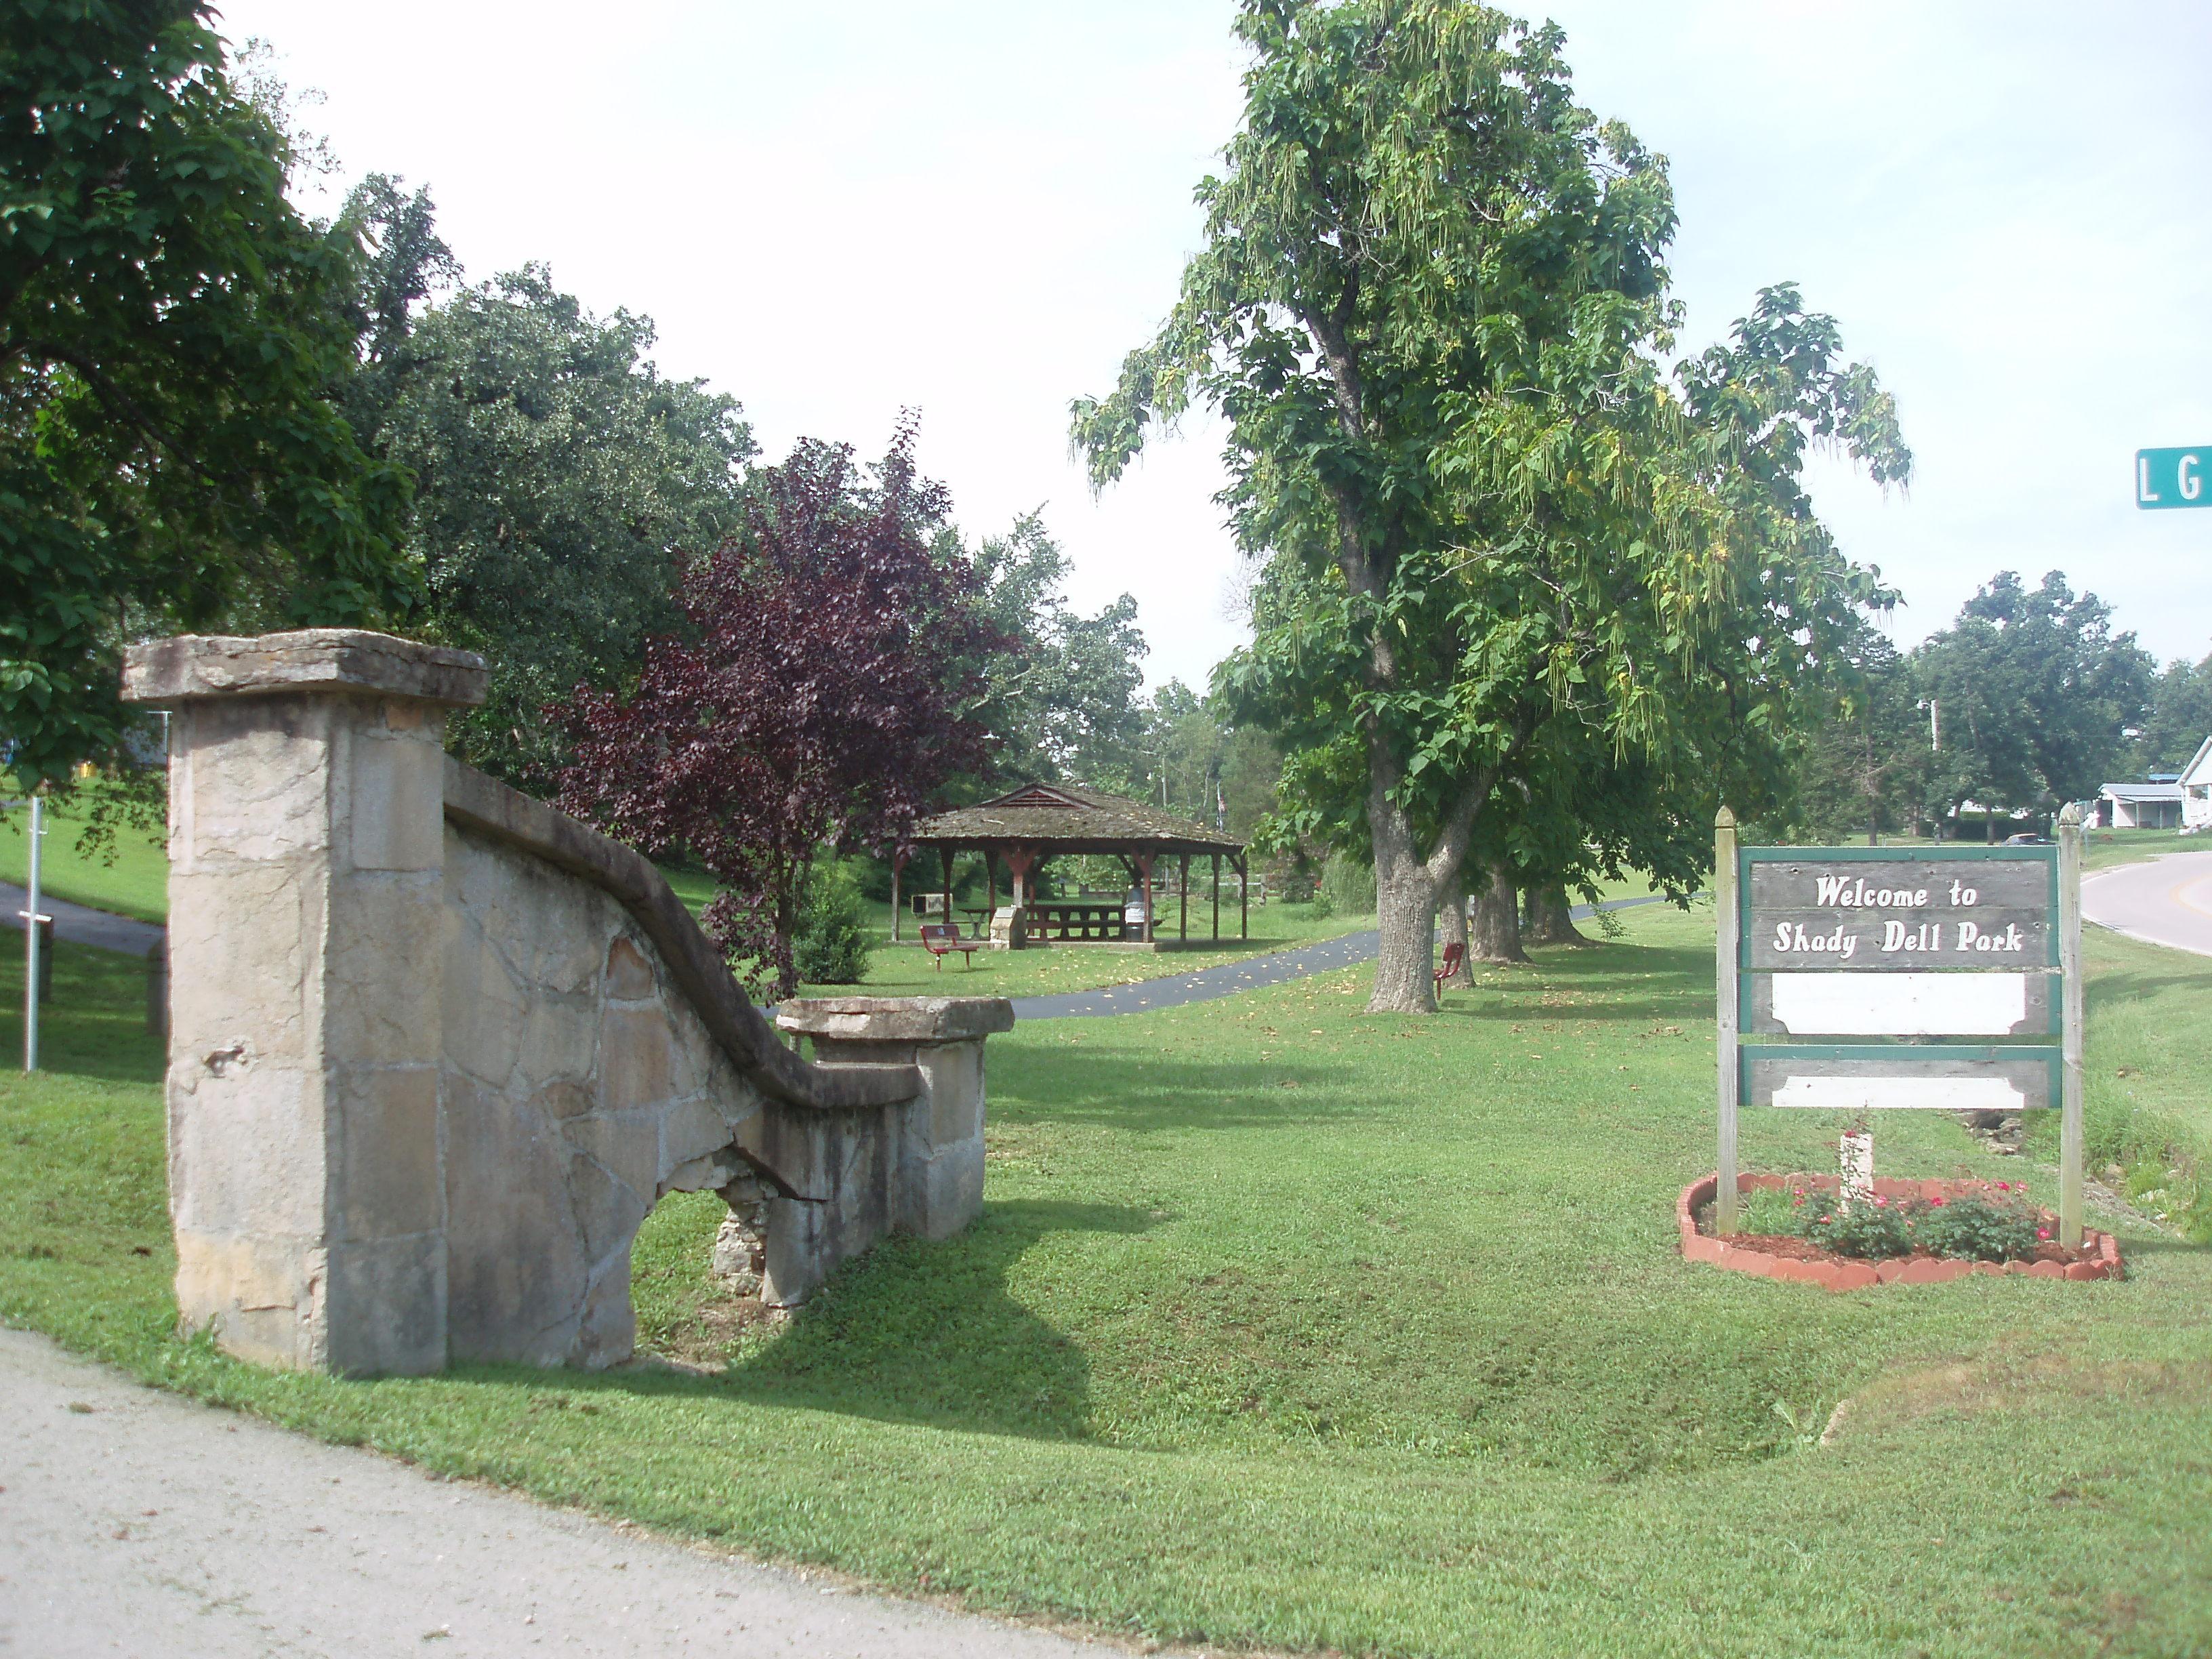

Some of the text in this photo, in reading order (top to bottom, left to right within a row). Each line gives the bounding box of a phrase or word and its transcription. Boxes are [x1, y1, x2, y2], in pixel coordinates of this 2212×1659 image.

[1816, 876, 1978, 907] Welcome to
[1772, 920, 2023, 960] Shady Dell Park
